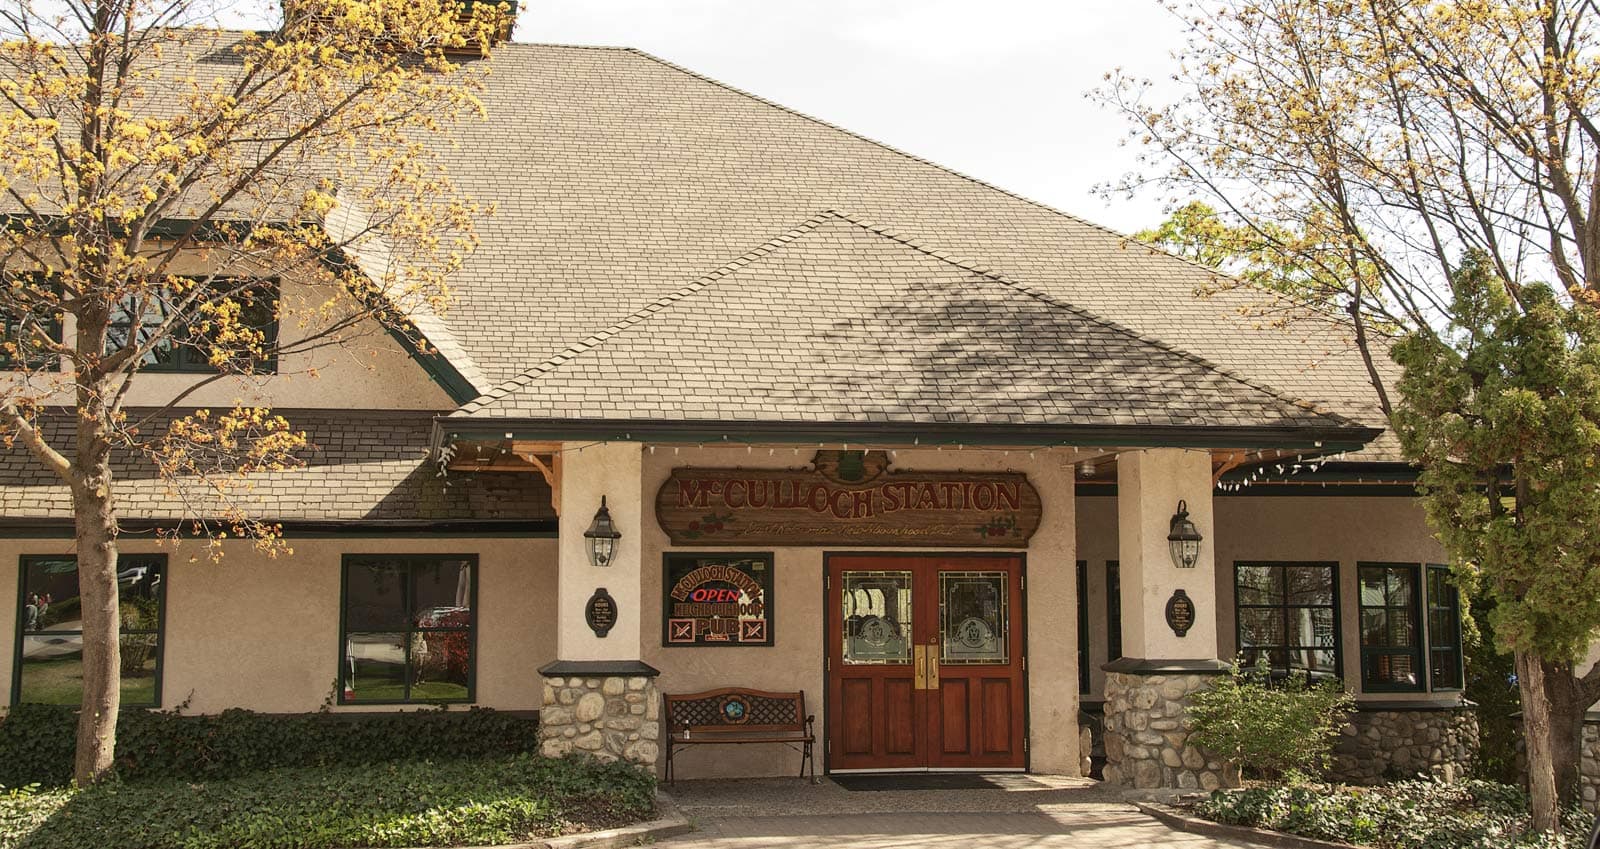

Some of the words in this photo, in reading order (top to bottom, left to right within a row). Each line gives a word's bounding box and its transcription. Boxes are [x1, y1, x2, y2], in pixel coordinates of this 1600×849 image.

[881, 480, 1023, 514] STATION
[692, 588, 740, 602] OPEN
[695, 618, 741, 636] PUB
